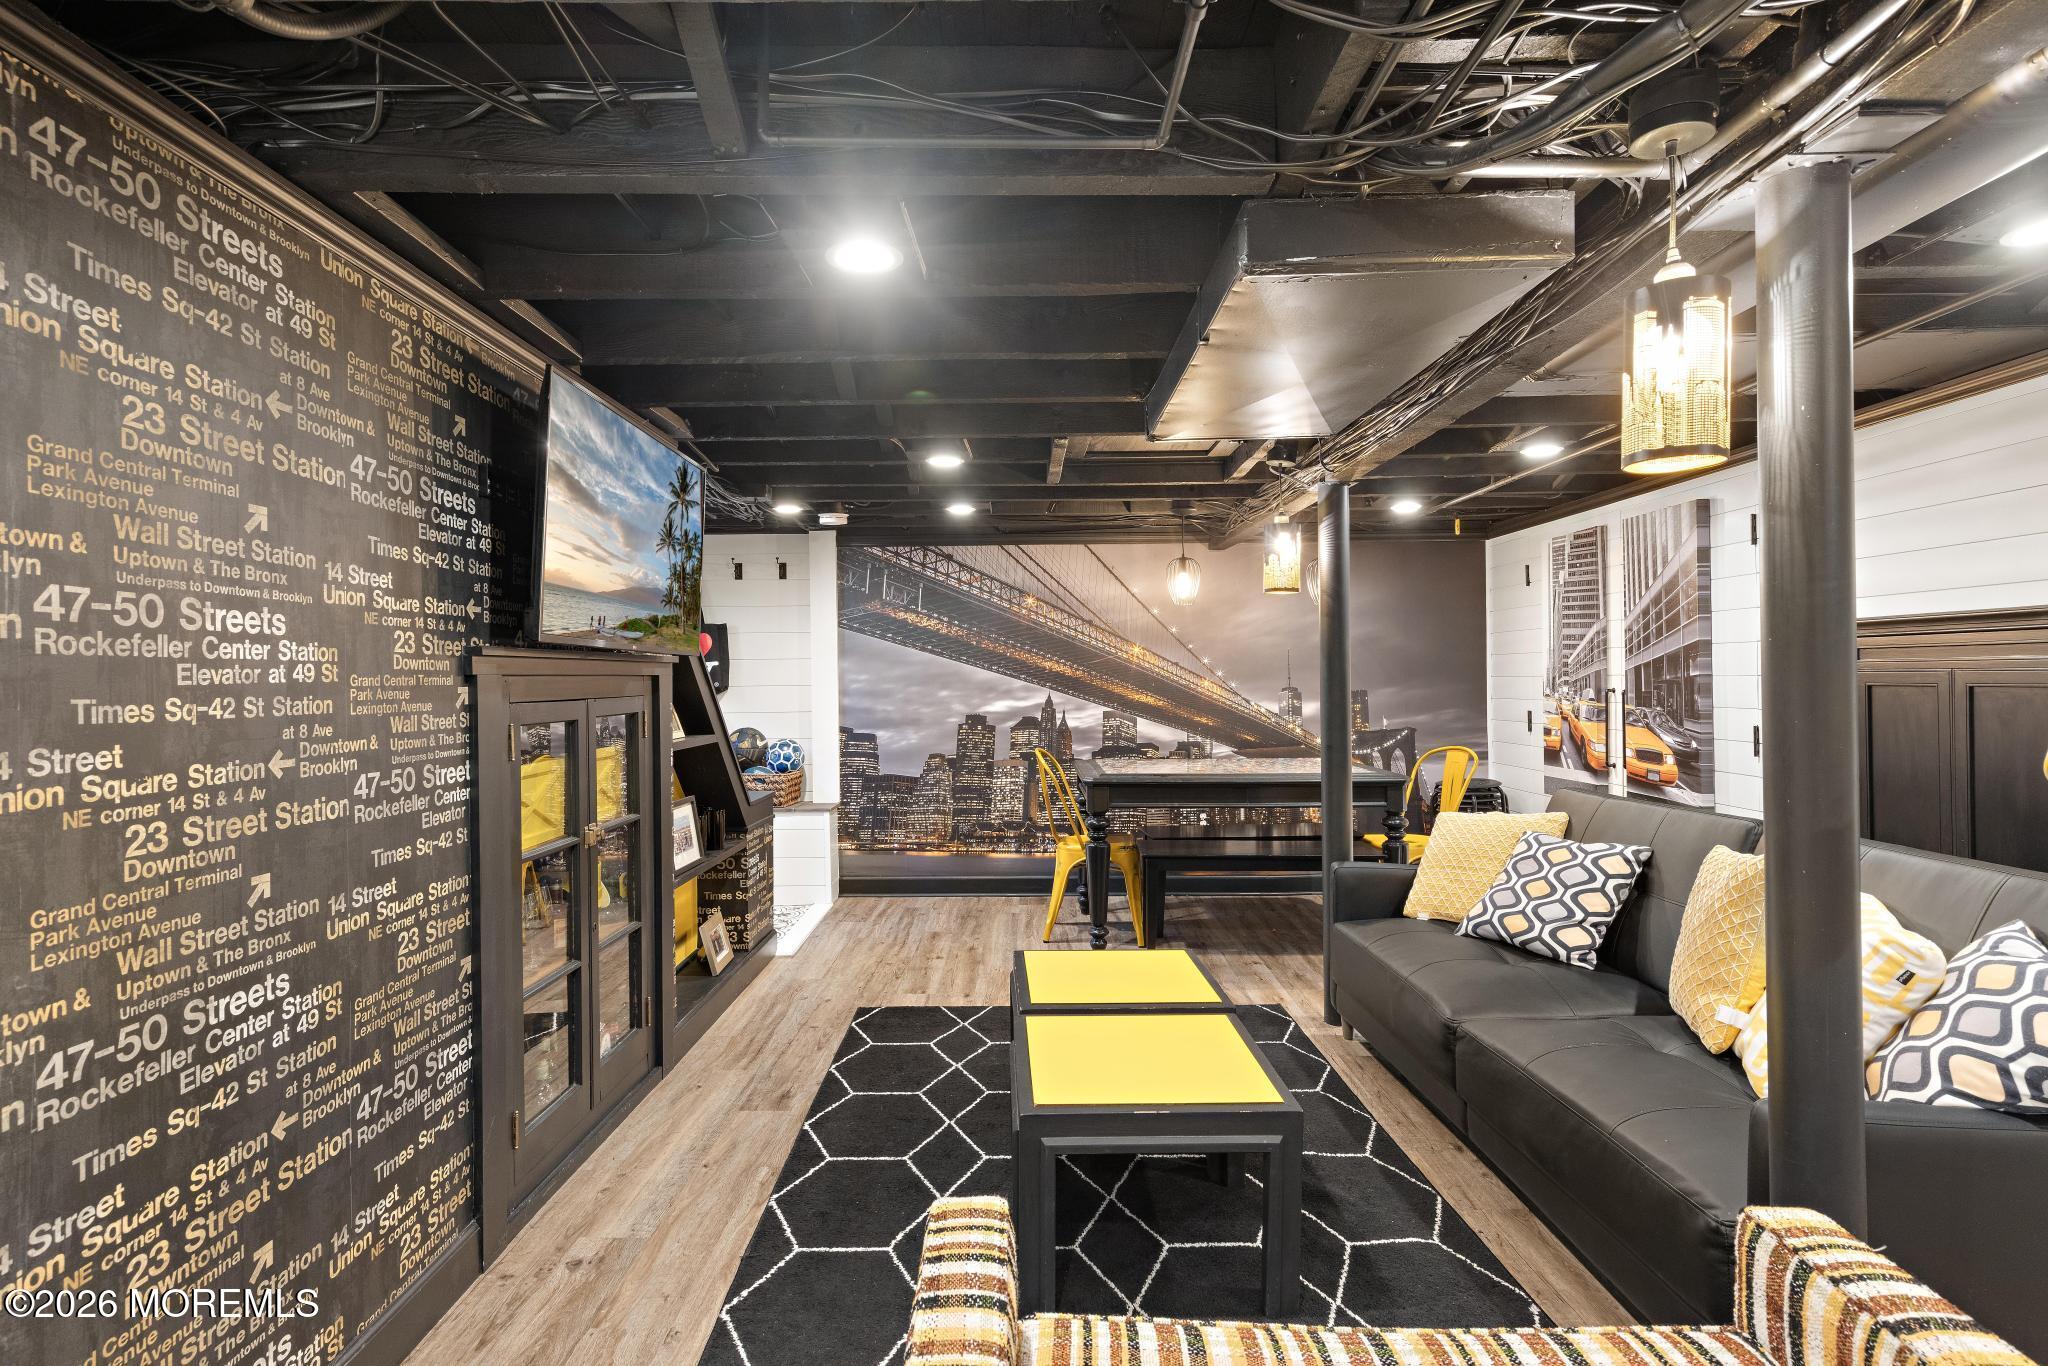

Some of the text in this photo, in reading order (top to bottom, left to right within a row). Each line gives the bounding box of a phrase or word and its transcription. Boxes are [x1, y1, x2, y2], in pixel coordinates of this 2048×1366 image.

[29, 117, 161, 210] 47-50
[176, 195, 283, 278] Streets
[112, 139, 310, 261] Underpass Downtown Brooklyn
[30, 153, 189, 255] Rockefeller
[199, 244, 268, 295] Center
[275, 283, 335, 331] Station
[321, 248, 363, 289] Union
[23, 273, 120, 333] Street
[67, 241, 330, 379] Times Sq-42 St Station
[174, 257, 336, 351] Elevator at 49 St
[0, 302, 262, 410] nion Square Station
[390, 352, 447, 393] Downtown
[391, 330, 413, 359] 23
[419, 346, 464, 387] Street
[60, 350, 207, 414] NE corner 14 St
[310, 383, 330, 402] Ave
[297, 393, 364, 432] Downtown
[297, 413, 354, 448] Brooklyn
[387, 412, 454, 454] Wall Street
[121, 428, 233, 477] Downtown
[122, 395, 346, 488] 23 Street Station
[350, 454, 412, 495] 47-50
[420, 476, 476, 515] Streets
[350, 481, 426, 519] Rockefeller
[69, 532, 88, 554] &
[113, 514, 316, 570] Wall Street Station
[113, 545, 288, 585] Uptown The Bronx
[368, 535, 449, 569] Times Sq-42
[325, 561, 393, 589] 14 Street
[33, 584, 164, 628] 47-50
[180, 597, 286, 636] Streets
[323, 584, 465, 616] Union Square Station
[34, 627, 338, 662] Rockefeller Center Station
[177, 663, 338, 686] Elevator at 49 St
[350, 674, 453, 687] Grand Central Terminal
[70, 695, 333, 725] Times Sq-42 St Station
[282, 724, 333, 740] at 8 Ave
[27, 744, 123, 777] Street
[300, 734, 378, 758] Downtown &
[300, 757, 357, 778] Brooklyn
[0, 760, 265, 814] nion Square Station
[353, 767, 416, 799] 47-50
[63, 786, 266, 830] NE corner 14 St & 4 Av
[125, 796, 349, 858] 23 Street Station
[354, 794, 430, 824] Rockefeller
[422, 806, 466, 829] Elevator
[124, 845, 235, 883] Downtown
[371, 845, 412, 867] Times
[30, 863, 242, 929] Grand Central Terminal
[327, 892, 424, 940] Union Square
[328, 877, 397, 916] 14 Street
[698, 906, 721, 914] treet
[704, 891, 733, 901] Times
[30, 906, 157, 951] Park Avenue
[30, 912, 201, 972] Lexington Avenue
[116, 898, 319, 975] Wall Street Station
[398, 927, 419, 956] 23
[117, 931, 291, 1000] Uptown & The Bronx
[120, 941, 316, 1020] Underpass to Downtown & Brooklyn
[73, 987, 91, 1011] &
[36, 1014, 168, 1090] 47-50
[183, 973, 290, 1035] Streets
[180, 998, 342, 1095] Elevator at 49 St
[36, 1044, 196, 1132] Rockefeller
[206, 1010, 275, 1053] Center
[282, 981, 342, 1020] Station
[315, 1062, 336, 1082] Ave
[303, 1058, 371, 1109] Downtown
[303, 1083, 361, 1129] Brooklyn
[357, 1064, 418, 1120] 47-50
[72, 1036, 336, 1182] Times Sq-42 St Station
[357, 1084, 432, 1148] Rockefeller
[82, 1132, 268, 1257] Square Station
[127, 1127, 352, 1295] 23 Street Station
[354, 1184, 399, 1233] Street
[29, 1183, 125, 1257] Street
[102, 1190, 212, 1271] corner 14 St
[329, 1232, 372, 1279] Union
